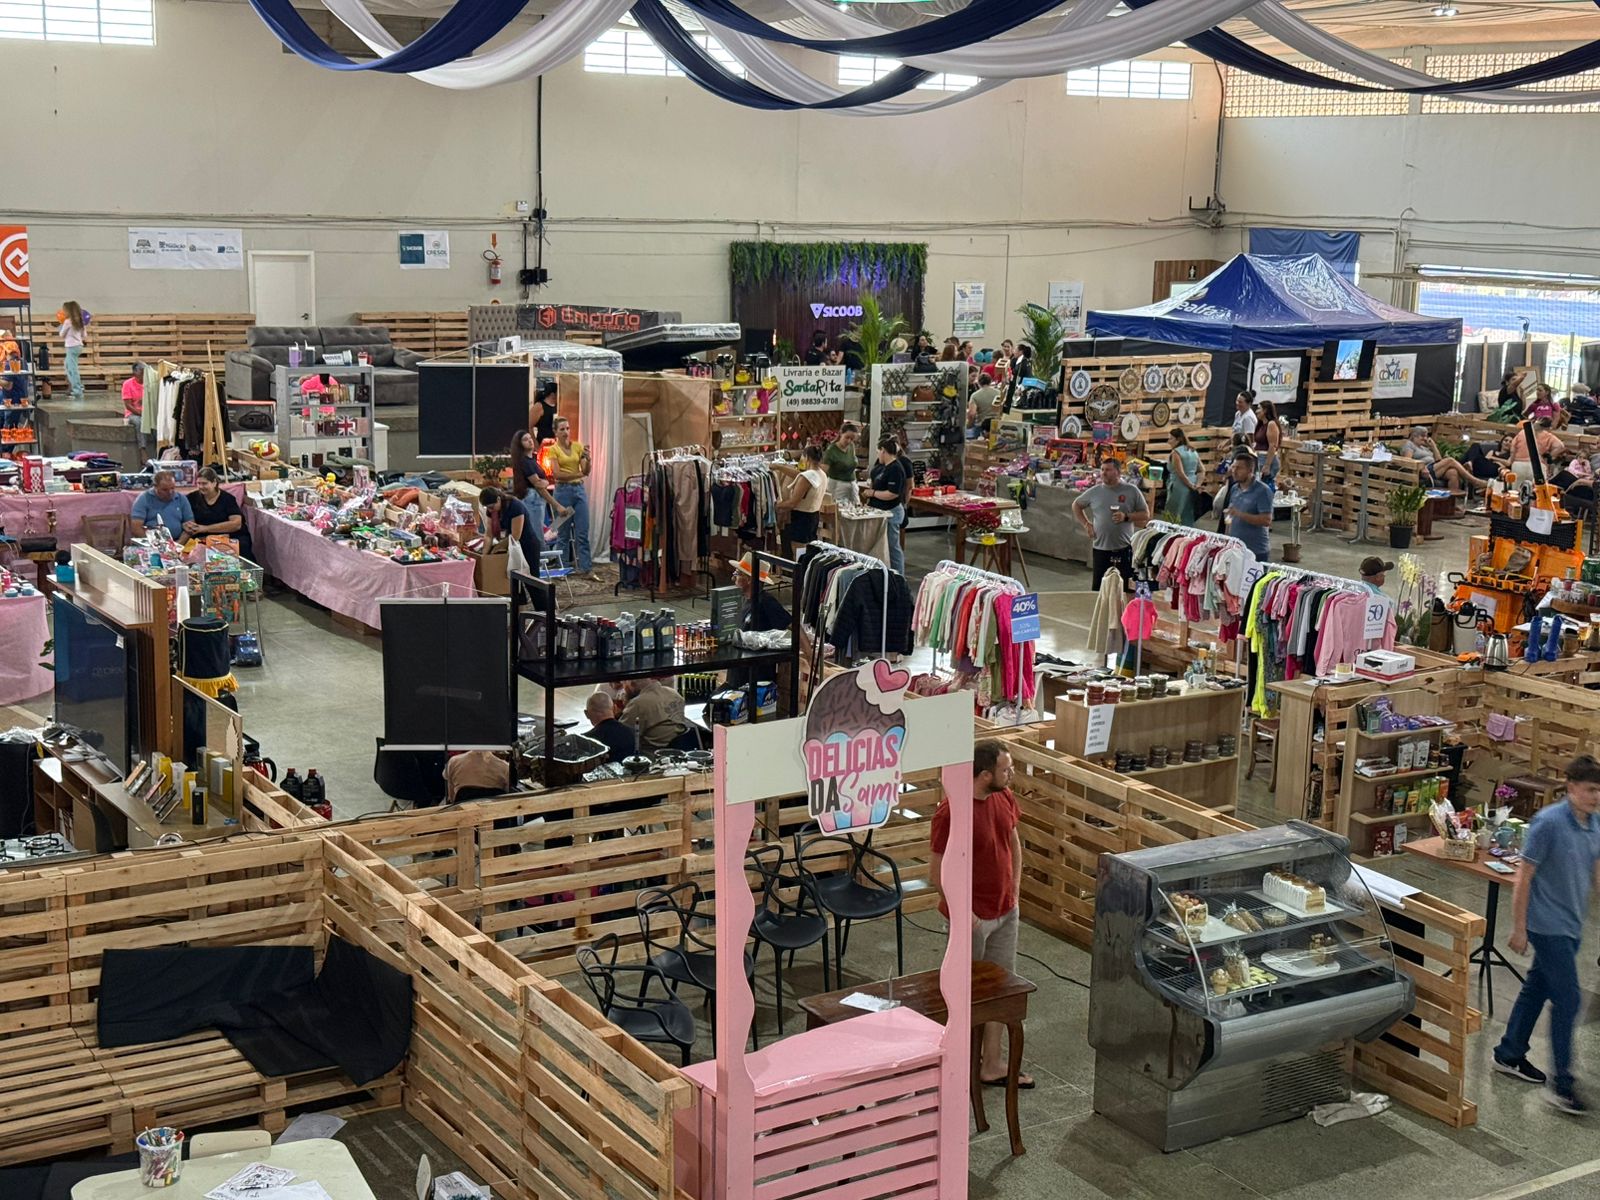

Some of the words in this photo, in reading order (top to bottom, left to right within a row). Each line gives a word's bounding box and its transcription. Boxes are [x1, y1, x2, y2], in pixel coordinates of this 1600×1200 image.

[823, 305, 863, 317] SICOOB
[783, 368, 812, 377] Livraria
[822, 368, 843, 376] Bazar
[1260, 370, 1293, 385] COMTUR
[1378, 367, 1408, 381] COMTUR
[786, 398, 799, 406] (49)
[801, 397, 839, 406] 98839-6708
[1012, 600, 1036, 613] 40%
[1367, 604, 1384, 622] 50
[808, 734, 899, 782] DELICIAS
[810, 775, 841, 816] DA
[838, 770, 900, 813] Sami
